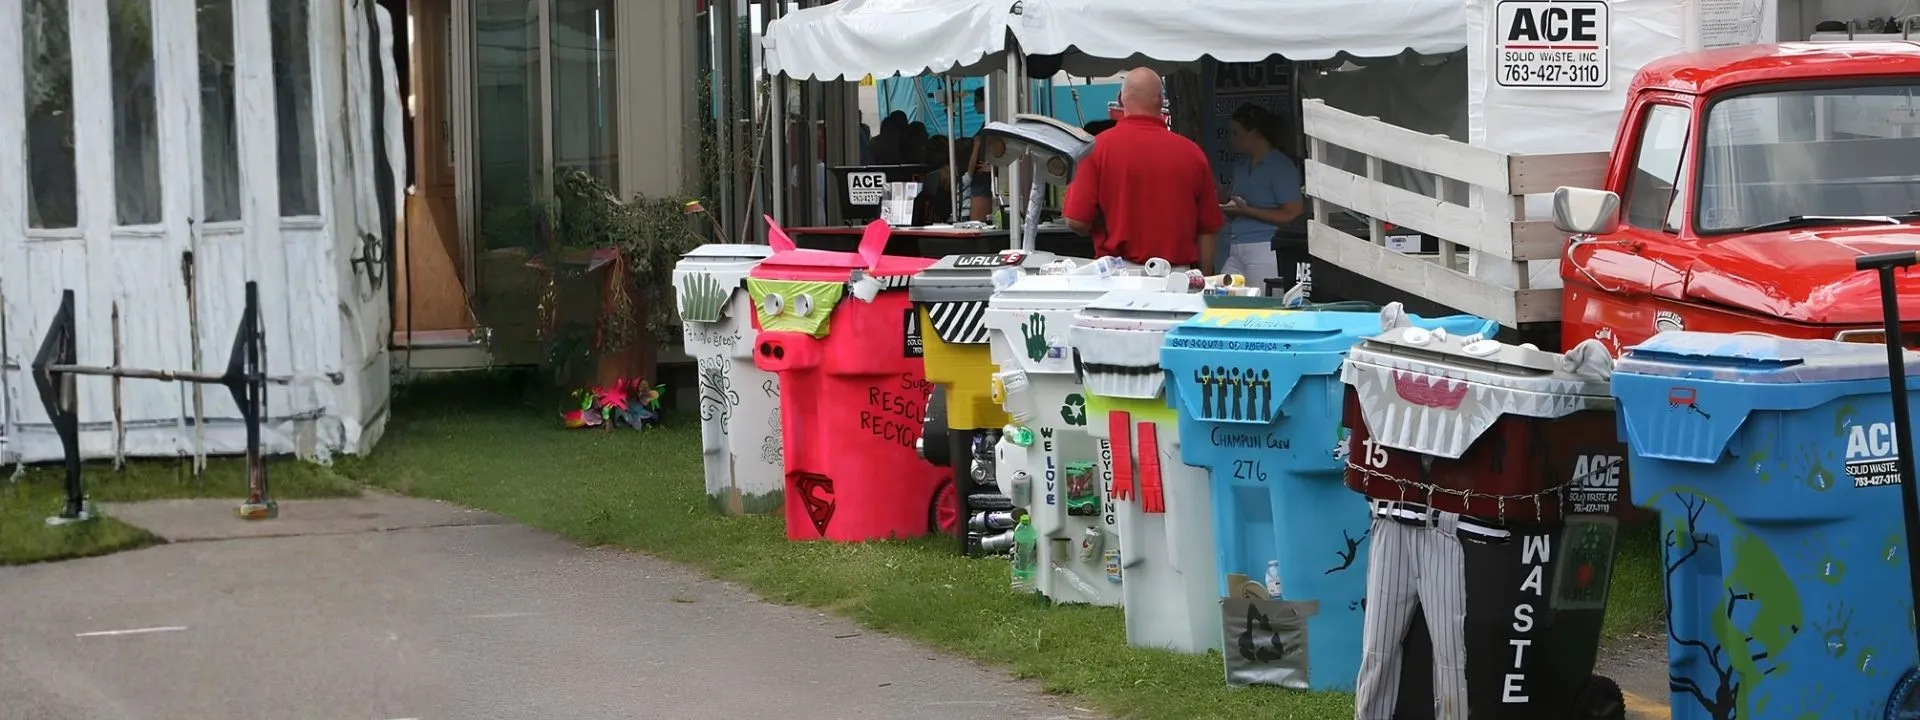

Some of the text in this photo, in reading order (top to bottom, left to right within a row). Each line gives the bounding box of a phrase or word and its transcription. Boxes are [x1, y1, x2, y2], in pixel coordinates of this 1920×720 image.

[1508, 8, 1597, 41] ACE
[1504, 65, 1599, 82] 763-427-3110
[1505, 52, 1534, 62] SOLID
[852, 175, 883, 188] ACE
[868, 386, 925, 425] RESCU
[861, 411, 917, 449] RECYCL
[1362, 437, 1389, 468] 15
[1045, 456, 1056, 505] LOVE
[1100, 439, 1116, 525] ECYCLING
[1233, 459, 1267, 481] 276
[1571, 454, 1622, 487] ACE
[1501, 534, 1550, 703] WASTE
